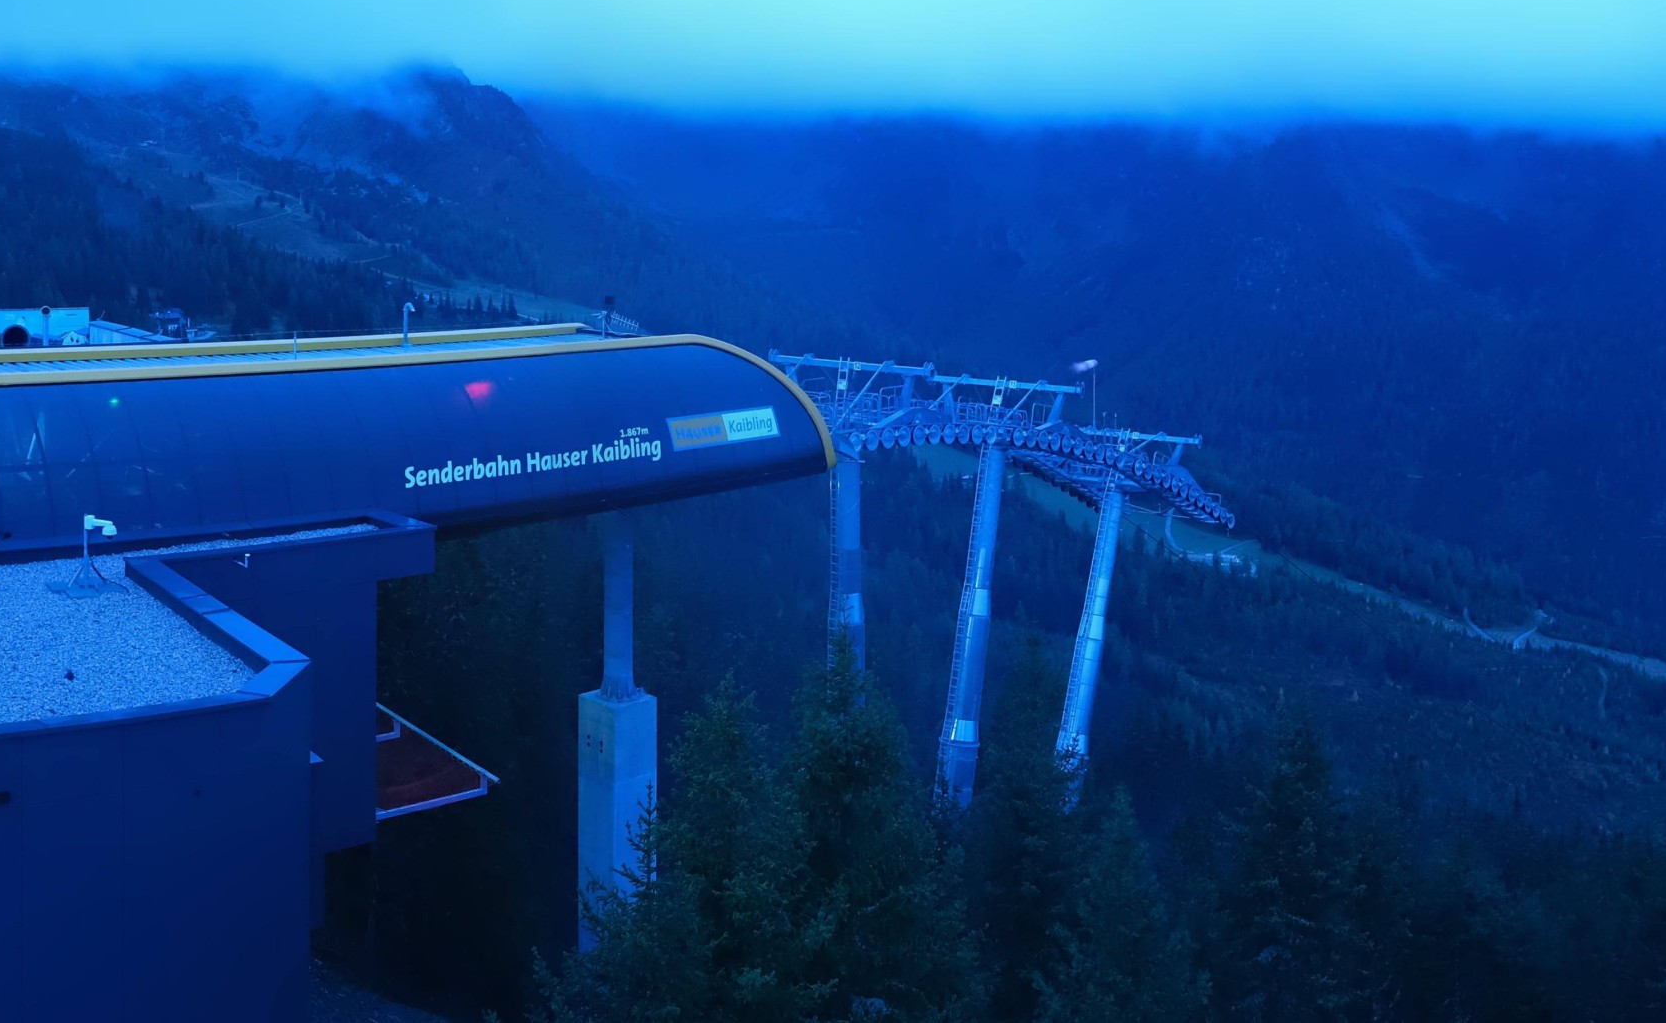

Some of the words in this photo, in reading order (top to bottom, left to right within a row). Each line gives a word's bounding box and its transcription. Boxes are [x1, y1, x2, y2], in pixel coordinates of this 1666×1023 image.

[619, 426, 649, 438] 1.867m
[728, 417, 773, 434] Kaibling
[404, 454, 522, 489] Senderbahn
[526, 448, 588, 473] Hauser
[592, 437, 662, 463] Kaibling
